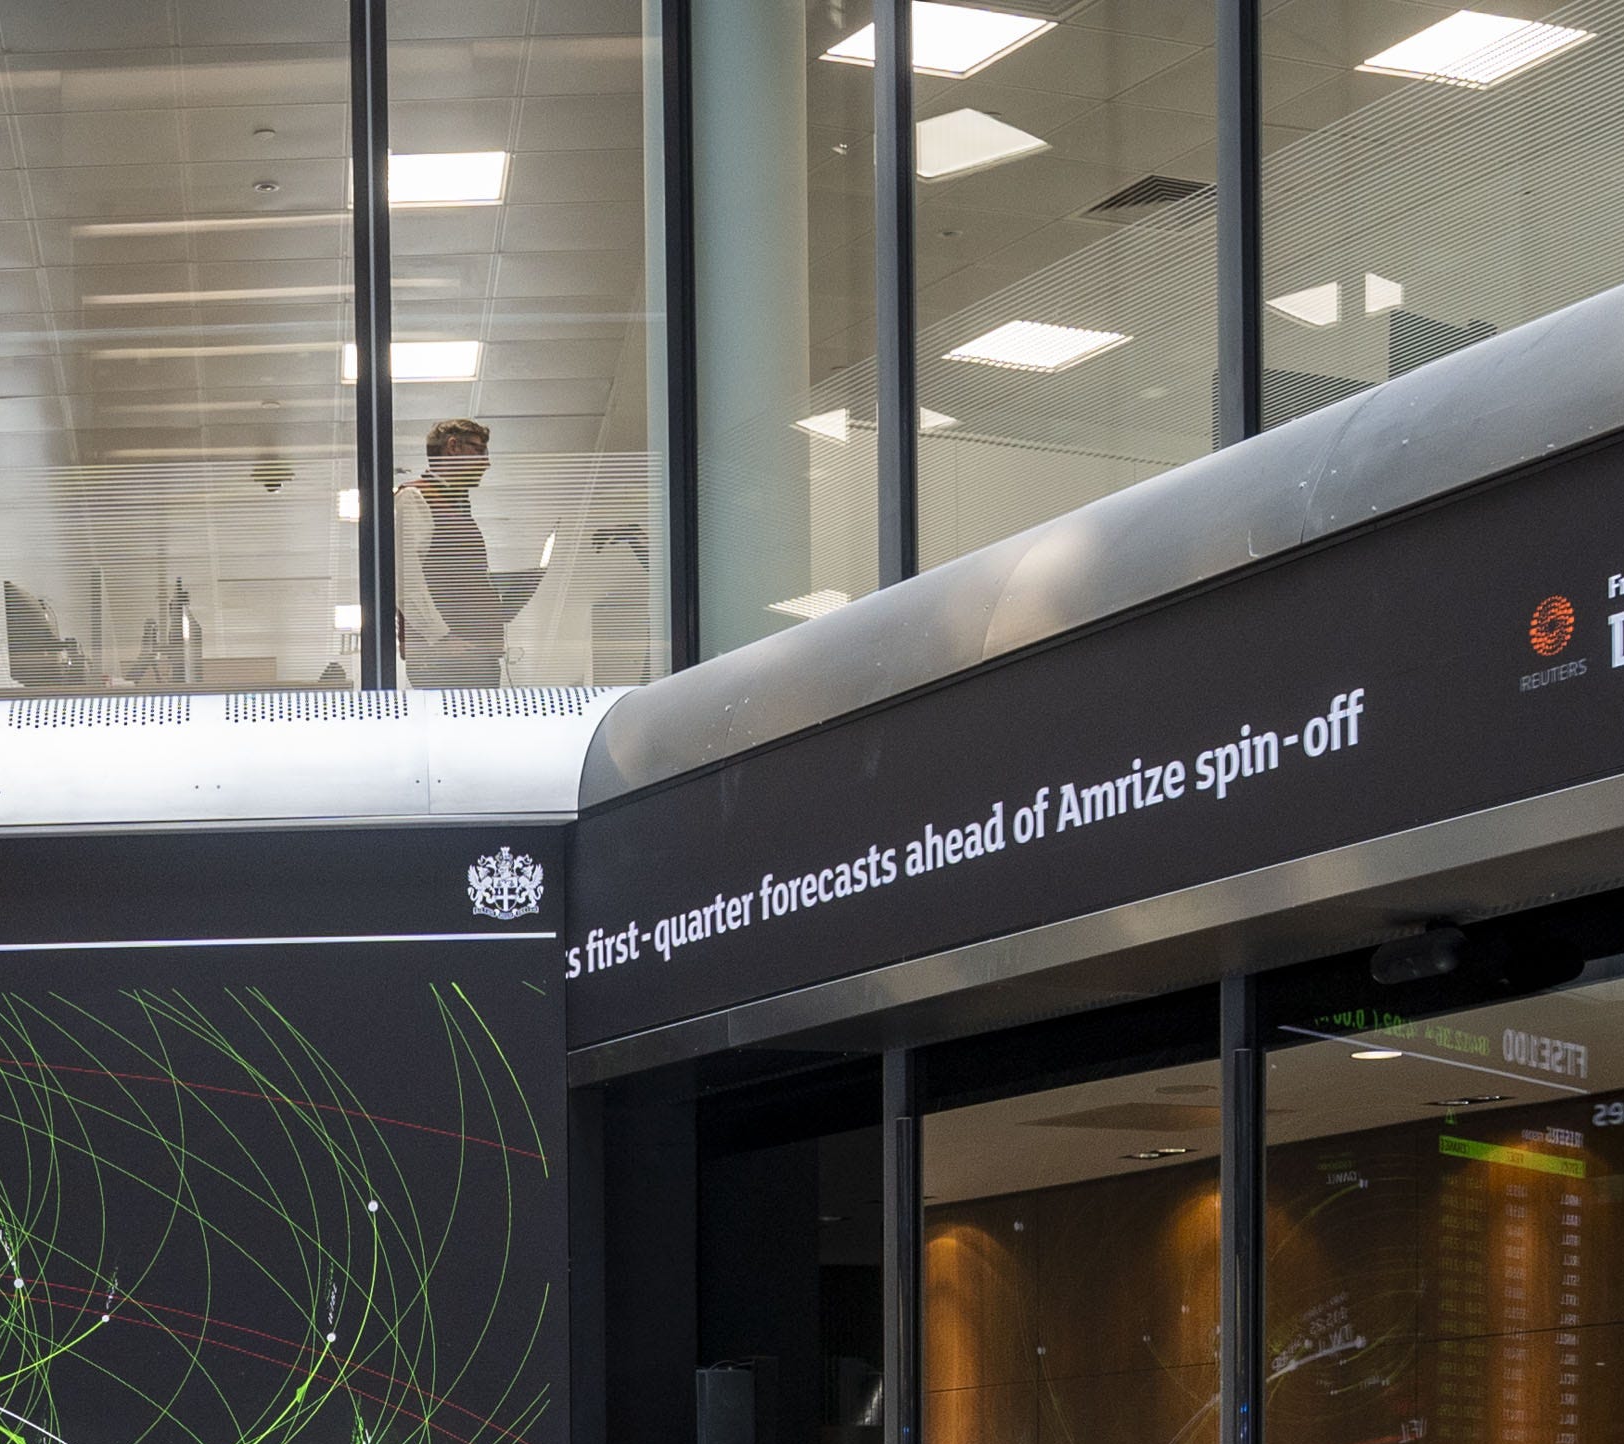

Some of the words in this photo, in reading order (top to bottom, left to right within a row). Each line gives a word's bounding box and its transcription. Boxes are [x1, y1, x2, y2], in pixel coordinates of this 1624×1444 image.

[1520, 658, 1587, 691] REUTERS
[586, 892, 754, 973] first-quarter
[759, 845, 897, 920] forecasts
[905, 801, 1006, 876] ahead
[1013, 787, 1049, 843] of
[1056, 758, 1185, 832] Amrize
[1196, 688, 1364, 799] spin-off
